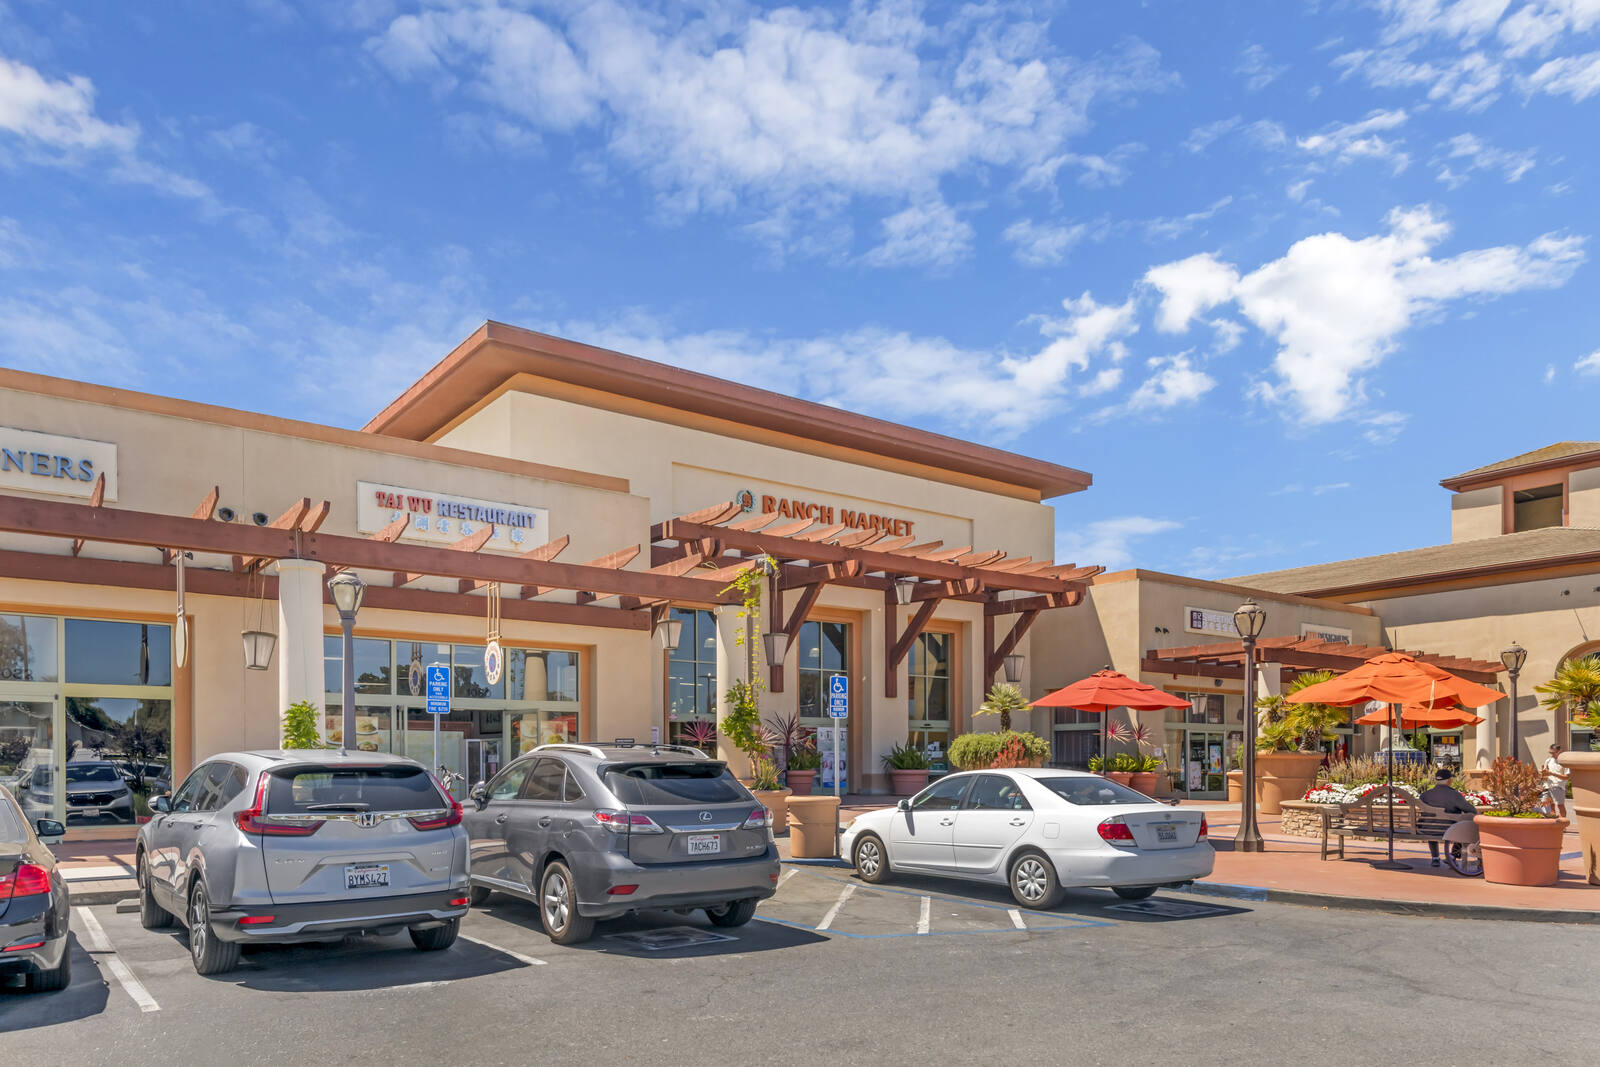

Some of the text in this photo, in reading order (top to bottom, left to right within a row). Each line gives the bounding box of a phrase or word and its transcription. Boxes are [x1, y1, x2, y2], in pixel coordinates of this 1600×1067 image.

[376, 491, 537, 529] TAI WU RESTAURANT
[762, 495, 834, 526] RANCH
[841, 509, 915, 537] MARKET
[689, 841, 718, 853] 7ACH673
[348, 872, 387, 885] 8YMS427
